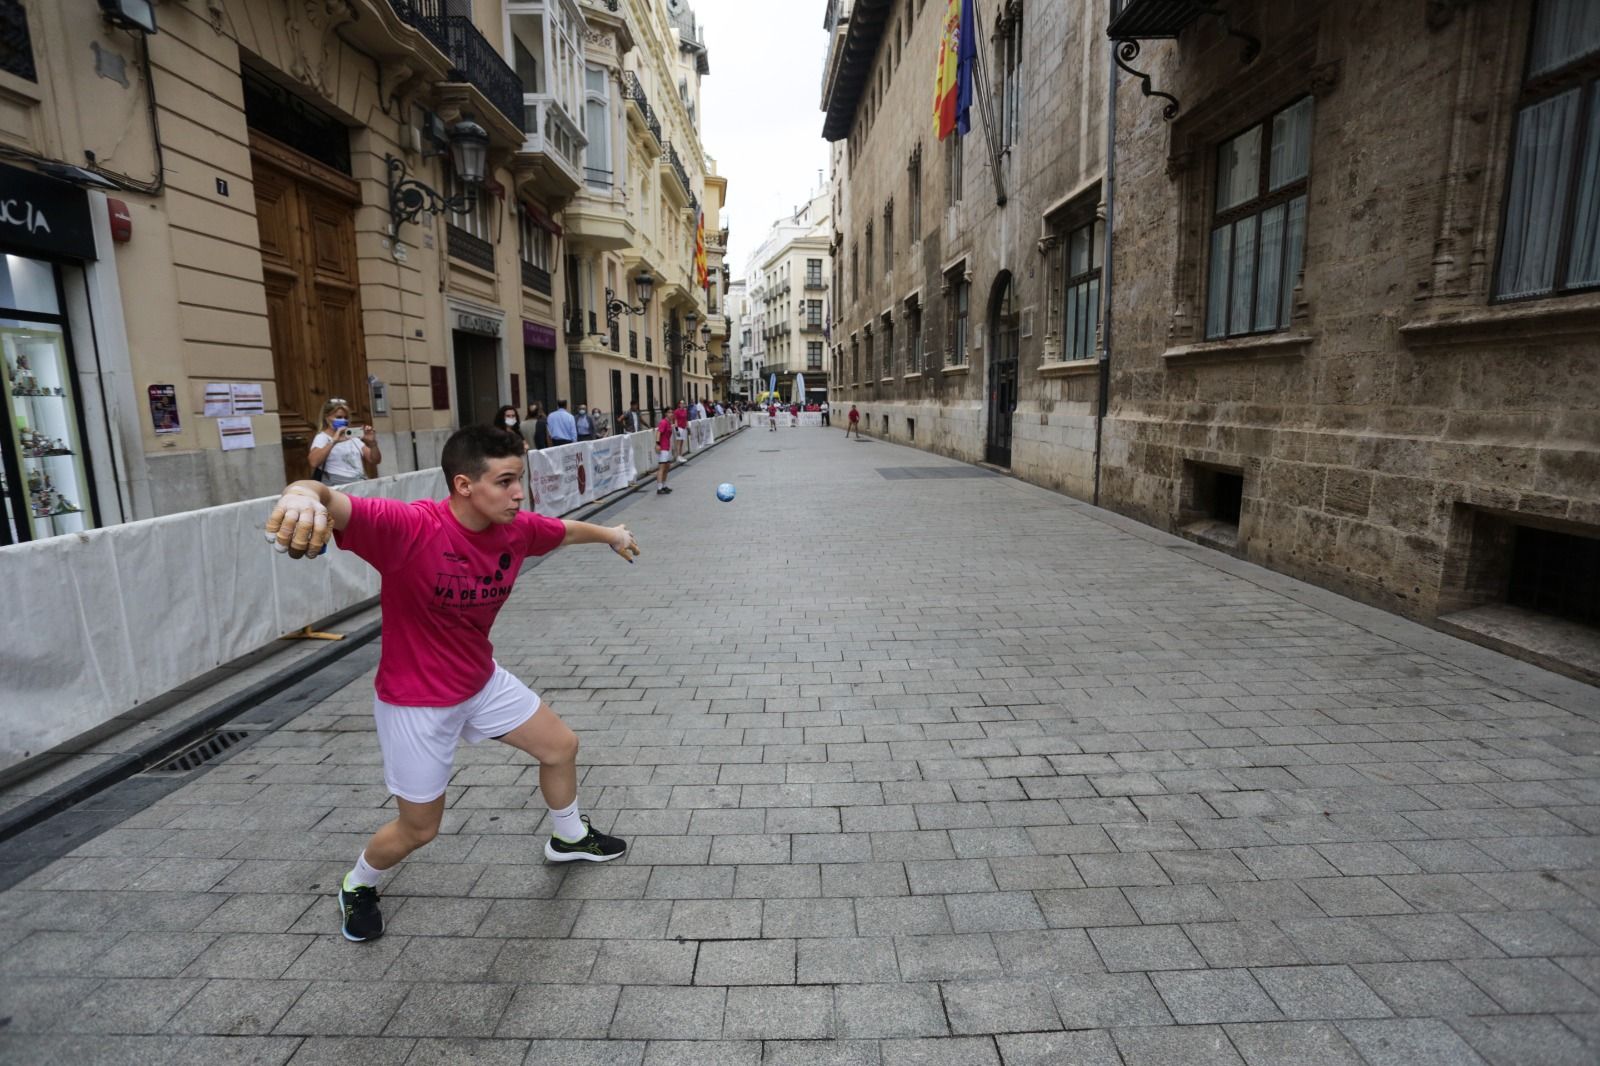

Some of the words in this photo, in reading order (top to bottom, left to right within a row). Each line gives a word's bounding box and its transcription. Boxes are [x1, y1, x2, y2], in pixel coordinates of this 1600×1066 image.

[218, 180, 225, 193] 7
[435, 586, 453, 599] VA
[461, 588, 477, 600] DE
